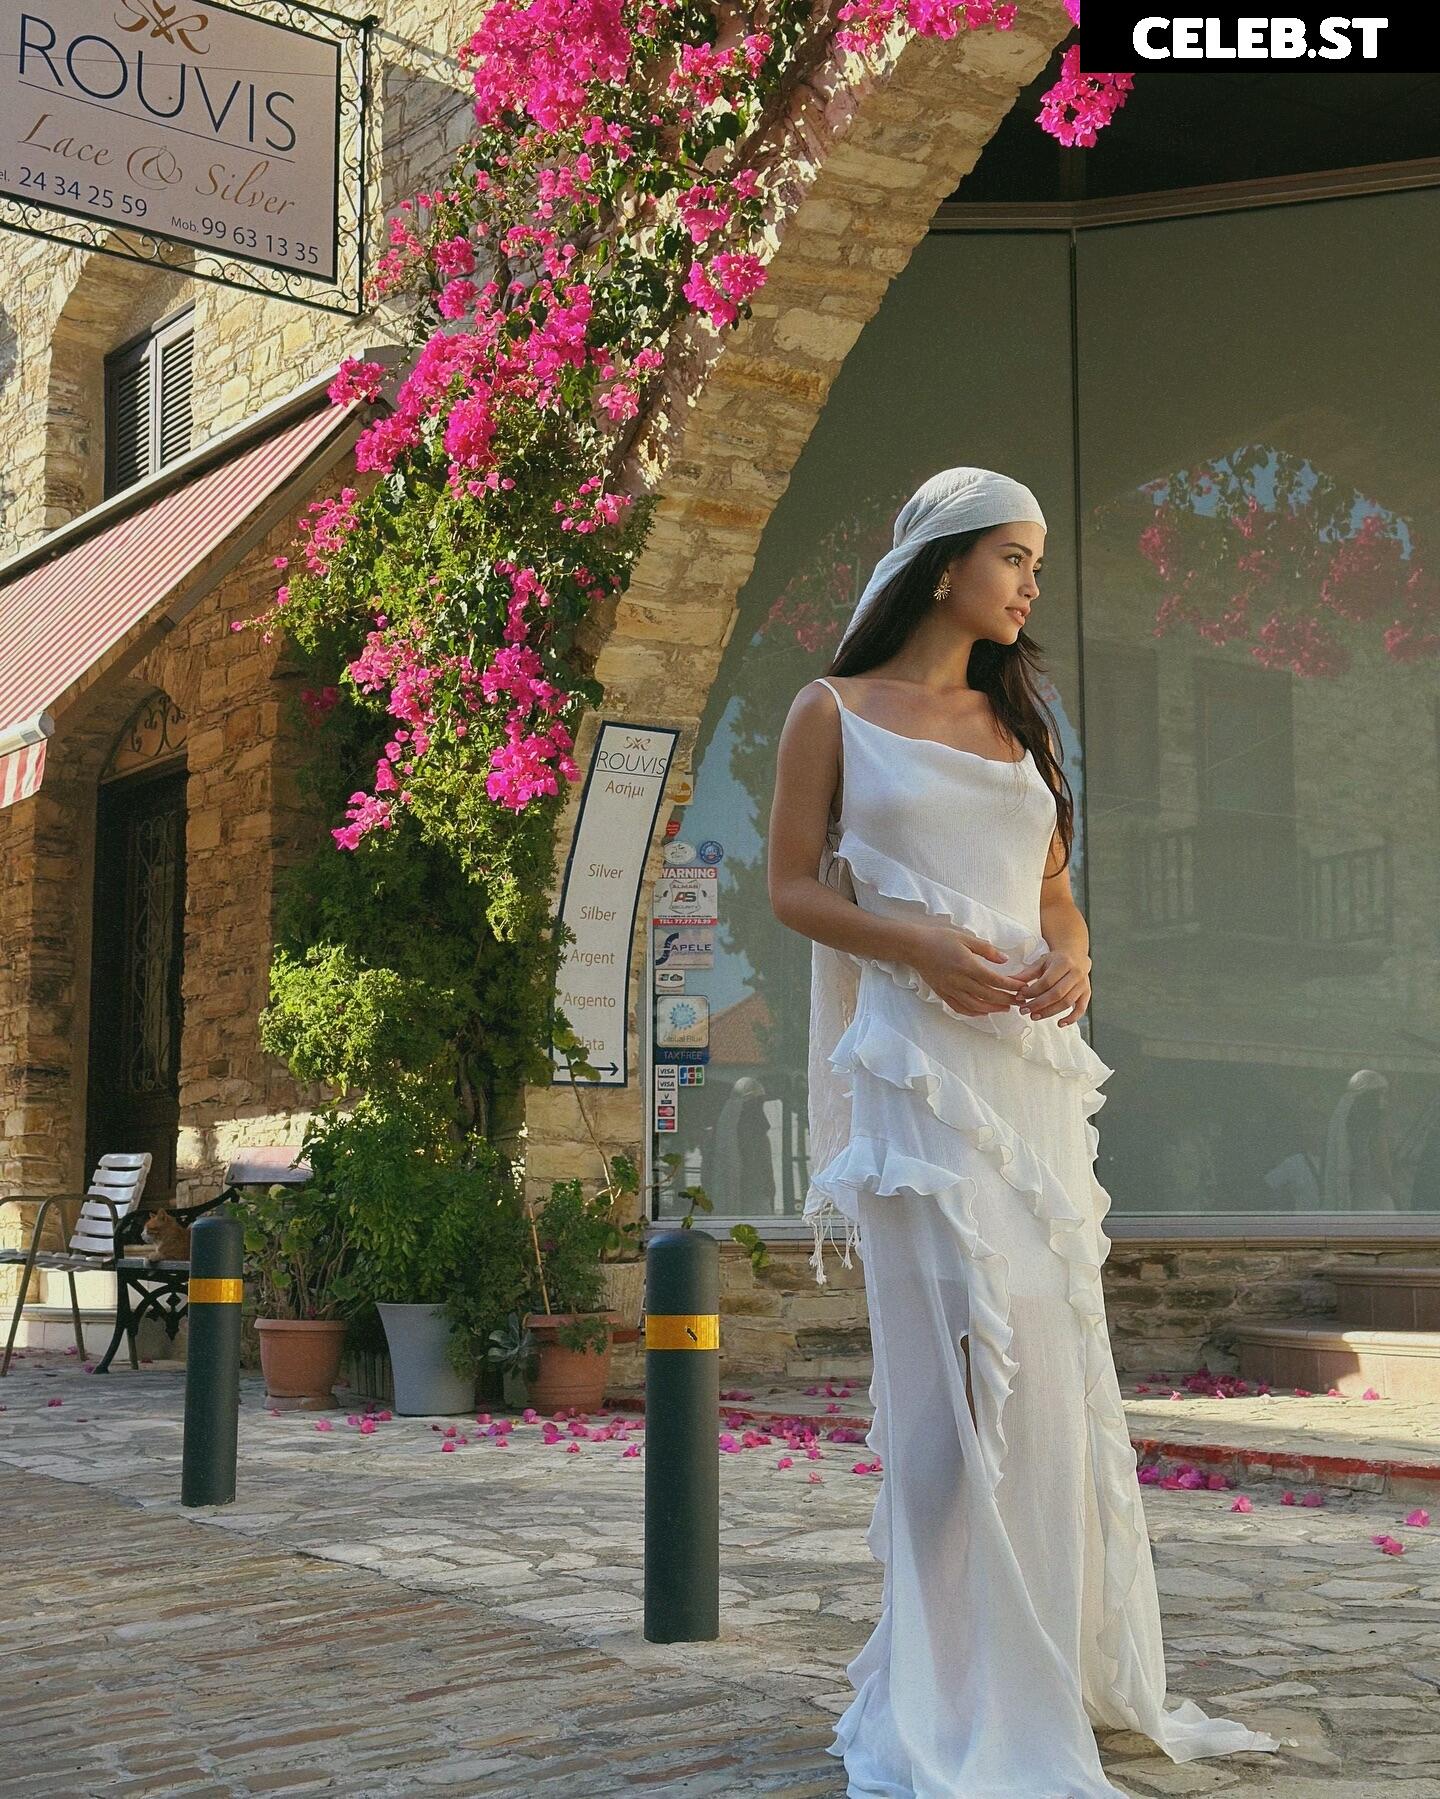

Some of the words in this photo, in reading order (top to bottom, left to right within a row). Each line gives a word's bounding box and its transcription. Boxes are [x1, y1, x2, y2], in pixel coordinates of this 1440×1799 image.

[18, 13, 297, 152] ROUVIS
[17, 113, 114, 166] Lace
[126, 145, 183, 191] &
[195, 160, 296, 216] Silver
[0, 169, 10, 183] el.
[18, 166, 47, 191] 24
[53, 175, 81, 200] 34
[87, 185, 114, 209] 25
[120, 194, 148, 217] 59
[171, 215, 200, 234] Mob.
[201, 216, 227, 239] 99
[232, 226, 258, 248] 63
[265, 234, 289, 257] 13
[294, 241, 319, 265] 35
[596, 750, 667, 776] ROUVIS
[604, 779, 645, 799] Ασήμι
[587, 863, 624, 879] Silver
[673, 891, 697, 903] AS
[579, 905, 617, 922] Silber
[570, 949, 616, 967] Argent
[562, 992, 617, 1010] Argento
[581, 1035, 605, 1051] lata
